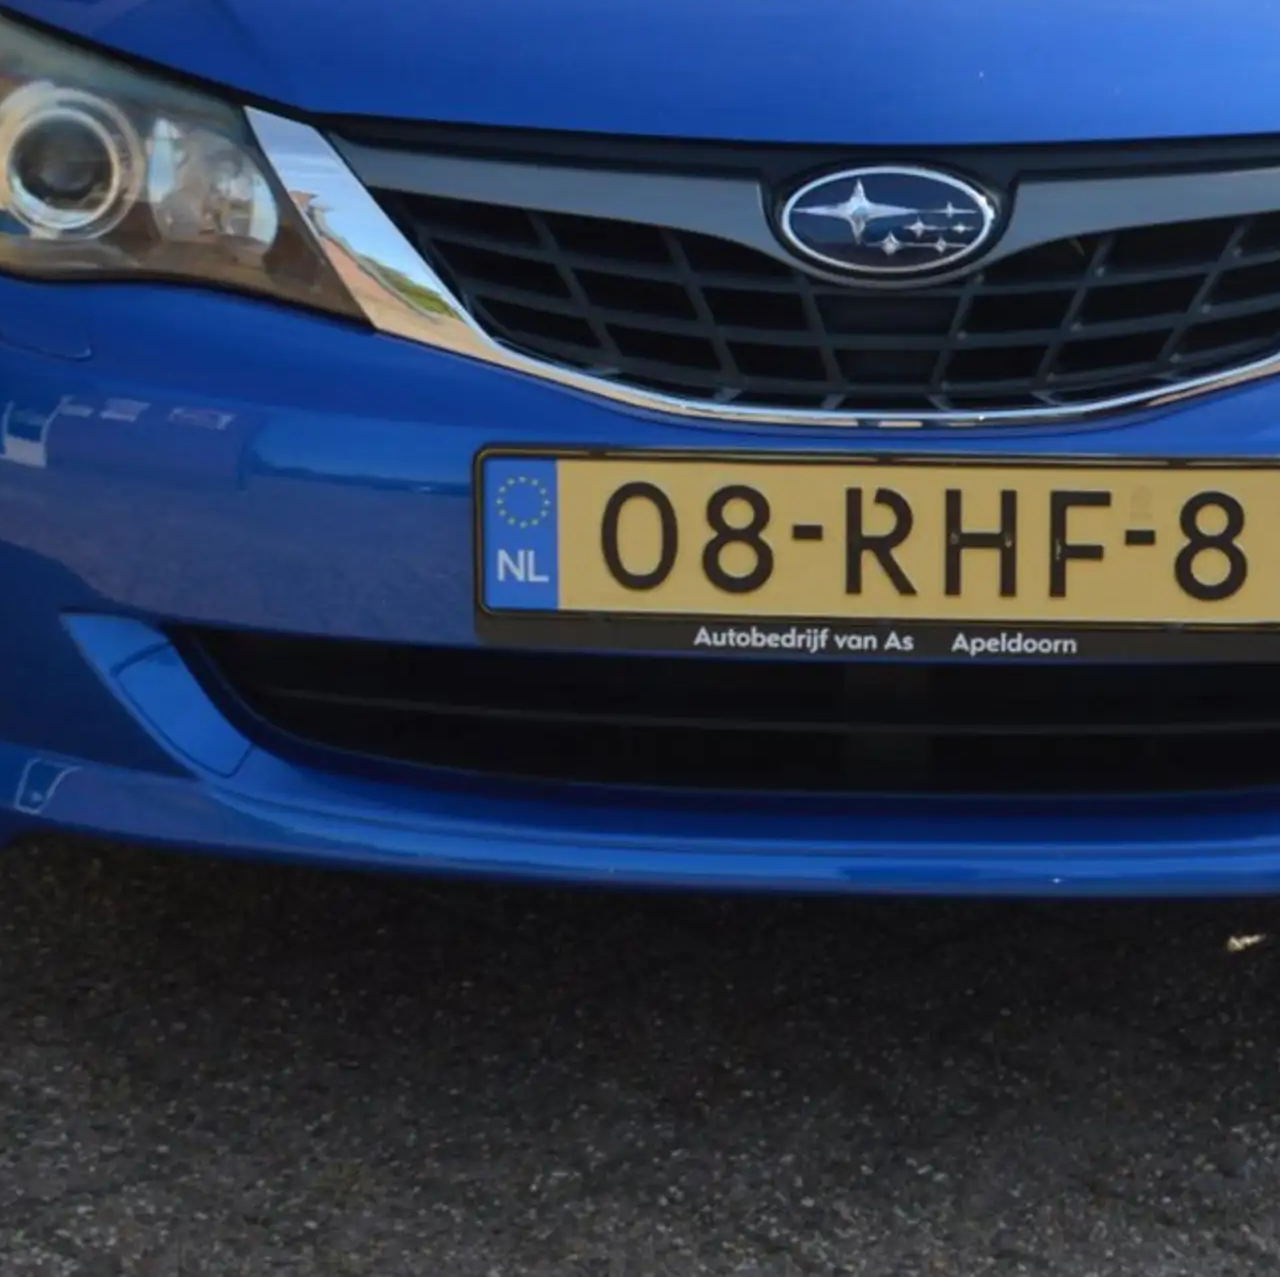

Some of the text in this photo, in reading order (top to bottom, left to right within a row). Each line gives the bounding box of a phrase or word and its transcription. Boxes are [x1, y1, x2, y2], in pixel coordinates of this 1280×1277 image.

[600, 481, 1249, 602] 08-RHF-8
[497, 548, 550, 582] NL
[693, 626, 915, 654] Autobedrijf van As
[951, 632, 1077, 657] Apeldoorn
